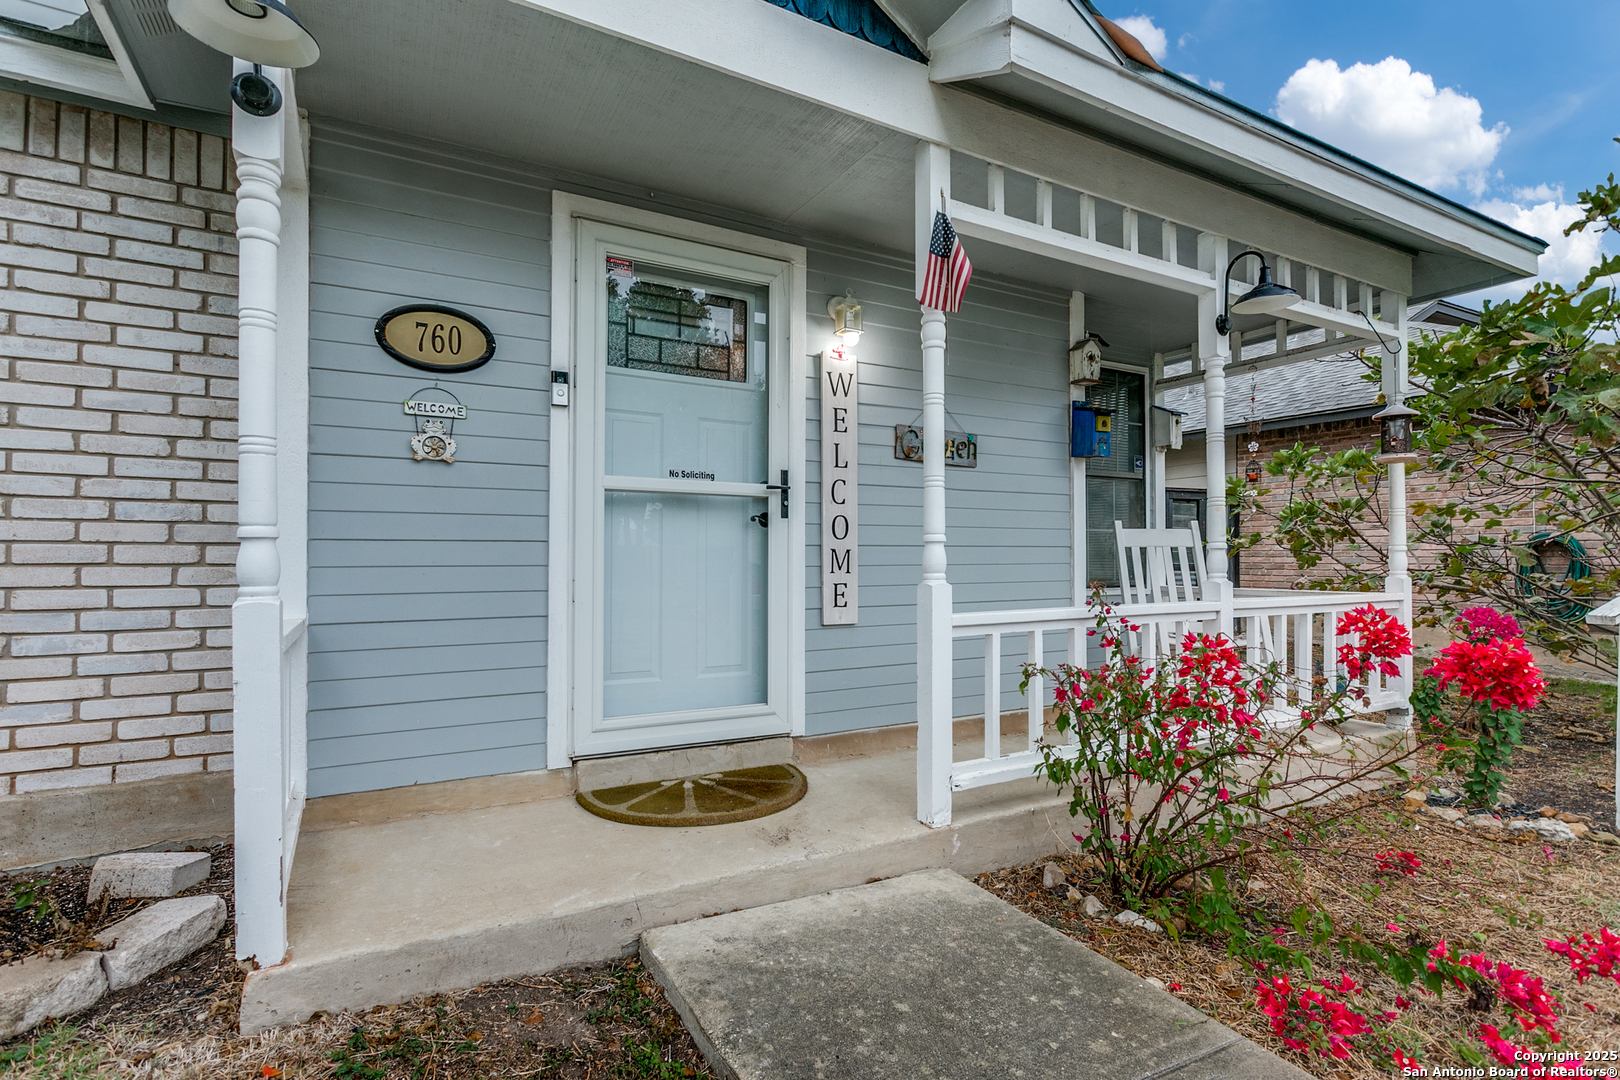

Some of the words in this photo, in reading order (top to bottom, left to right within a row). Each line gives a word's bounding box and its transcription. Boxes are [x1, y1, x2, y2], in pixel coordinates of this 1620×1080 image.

[415, 321, 462, 355] 760
[406, 402, 464, 417] WELCOME
[901, 429, 977, 460] Gden
[669, 470, 679, 478] No
[681, 470, 715, 481] Soliciting
[826, 371, 855, 609] WELCOME
